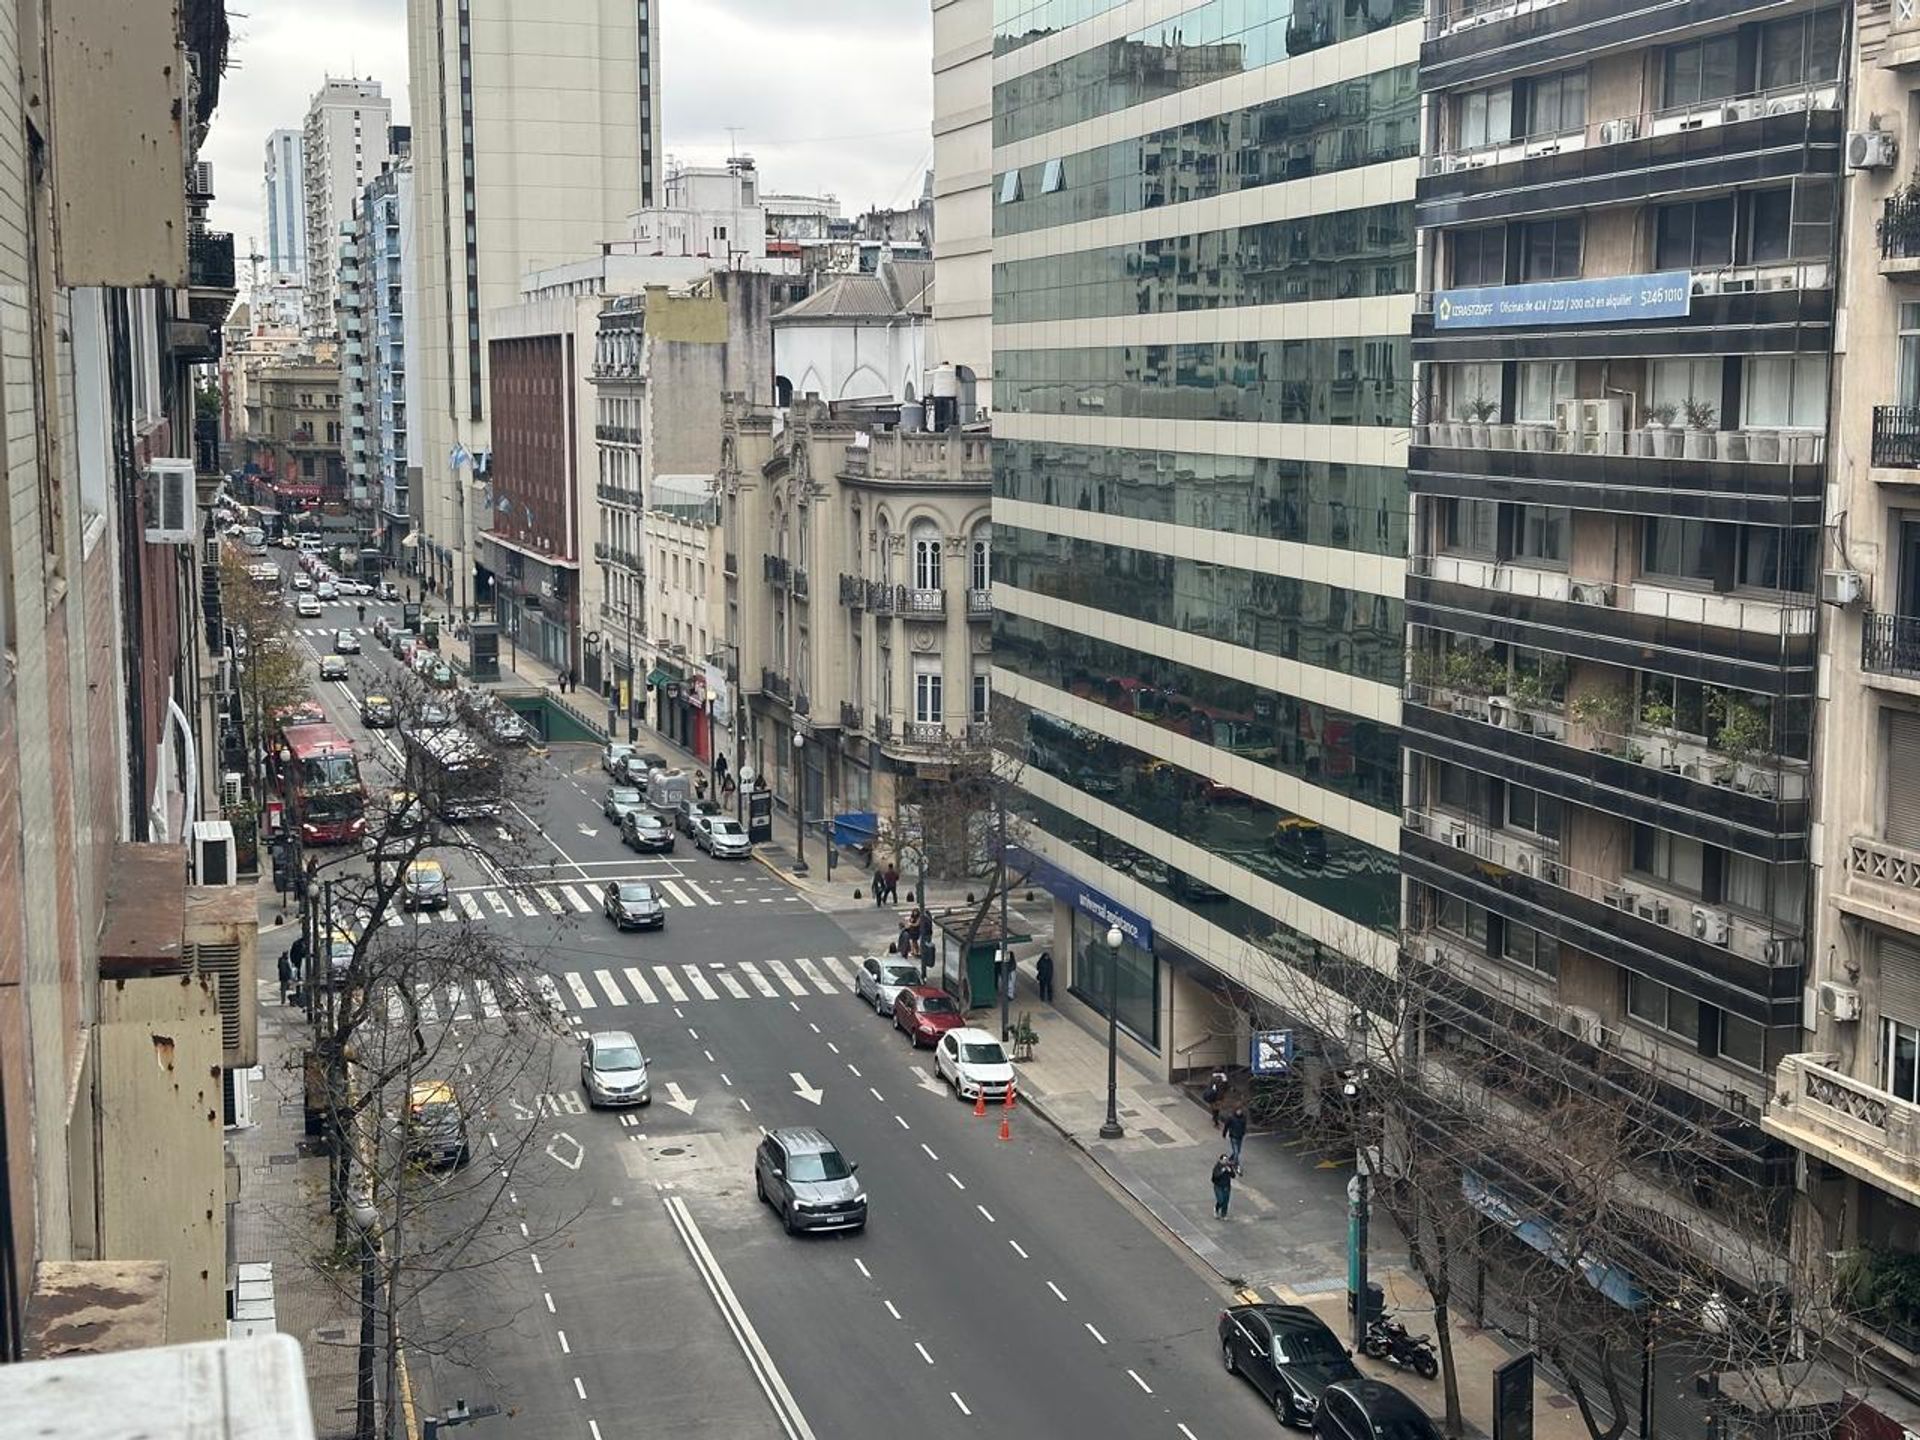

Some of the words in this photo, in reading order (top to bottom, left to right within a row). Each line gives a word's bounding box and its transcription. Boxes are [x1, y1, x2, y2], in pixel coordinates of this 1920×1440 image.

[1524, 299, 1533, 312] de
[1596, 296, 1605, 308] en
[1641, 287, 1684, 309] 52461010
[1079, 893, 1106, 919] universal
[1107, 909, 1138, 939] assistance
